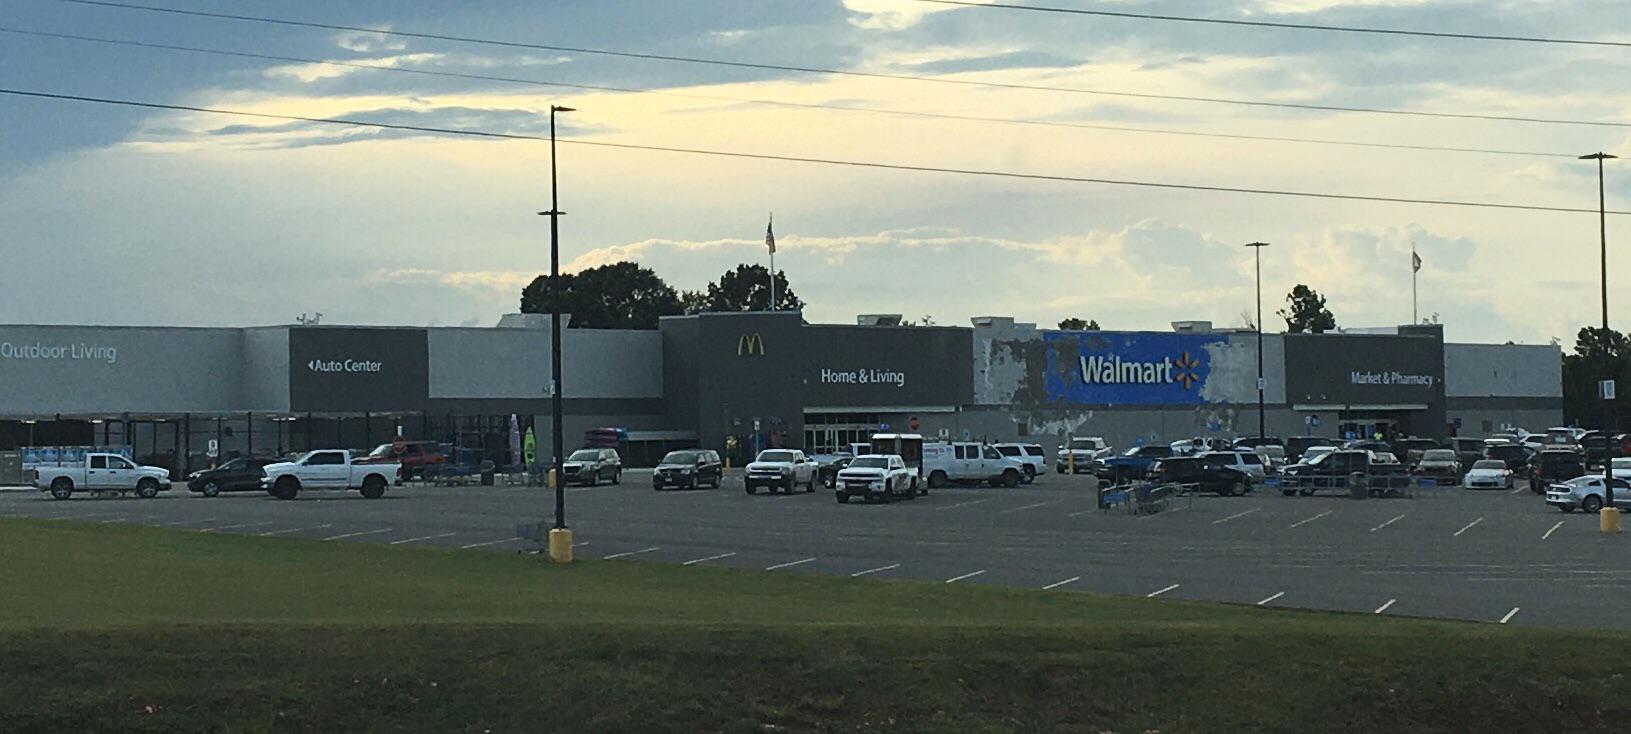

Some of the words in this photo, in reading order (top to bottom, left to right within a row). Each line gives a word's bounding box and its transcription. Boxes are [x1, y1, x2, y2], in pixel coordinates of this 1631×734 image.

[1, 342, 67, 359] Outdoor
[71, 343, 116, 363] Living
[314, 359, 343, 372] Auto
[344, 359, 382, 372] Center
[1080, 355, 1173, 384] Walmart
[821, 368, 857, 384] Home
[858, 368, 868, 384] &
[870, 368, 905, 387] Living
[1351, 371, 1382, 384] Market
[1383, 371, 1390, 384] &
[1391, 371, 1433, 389] Pharmacy
